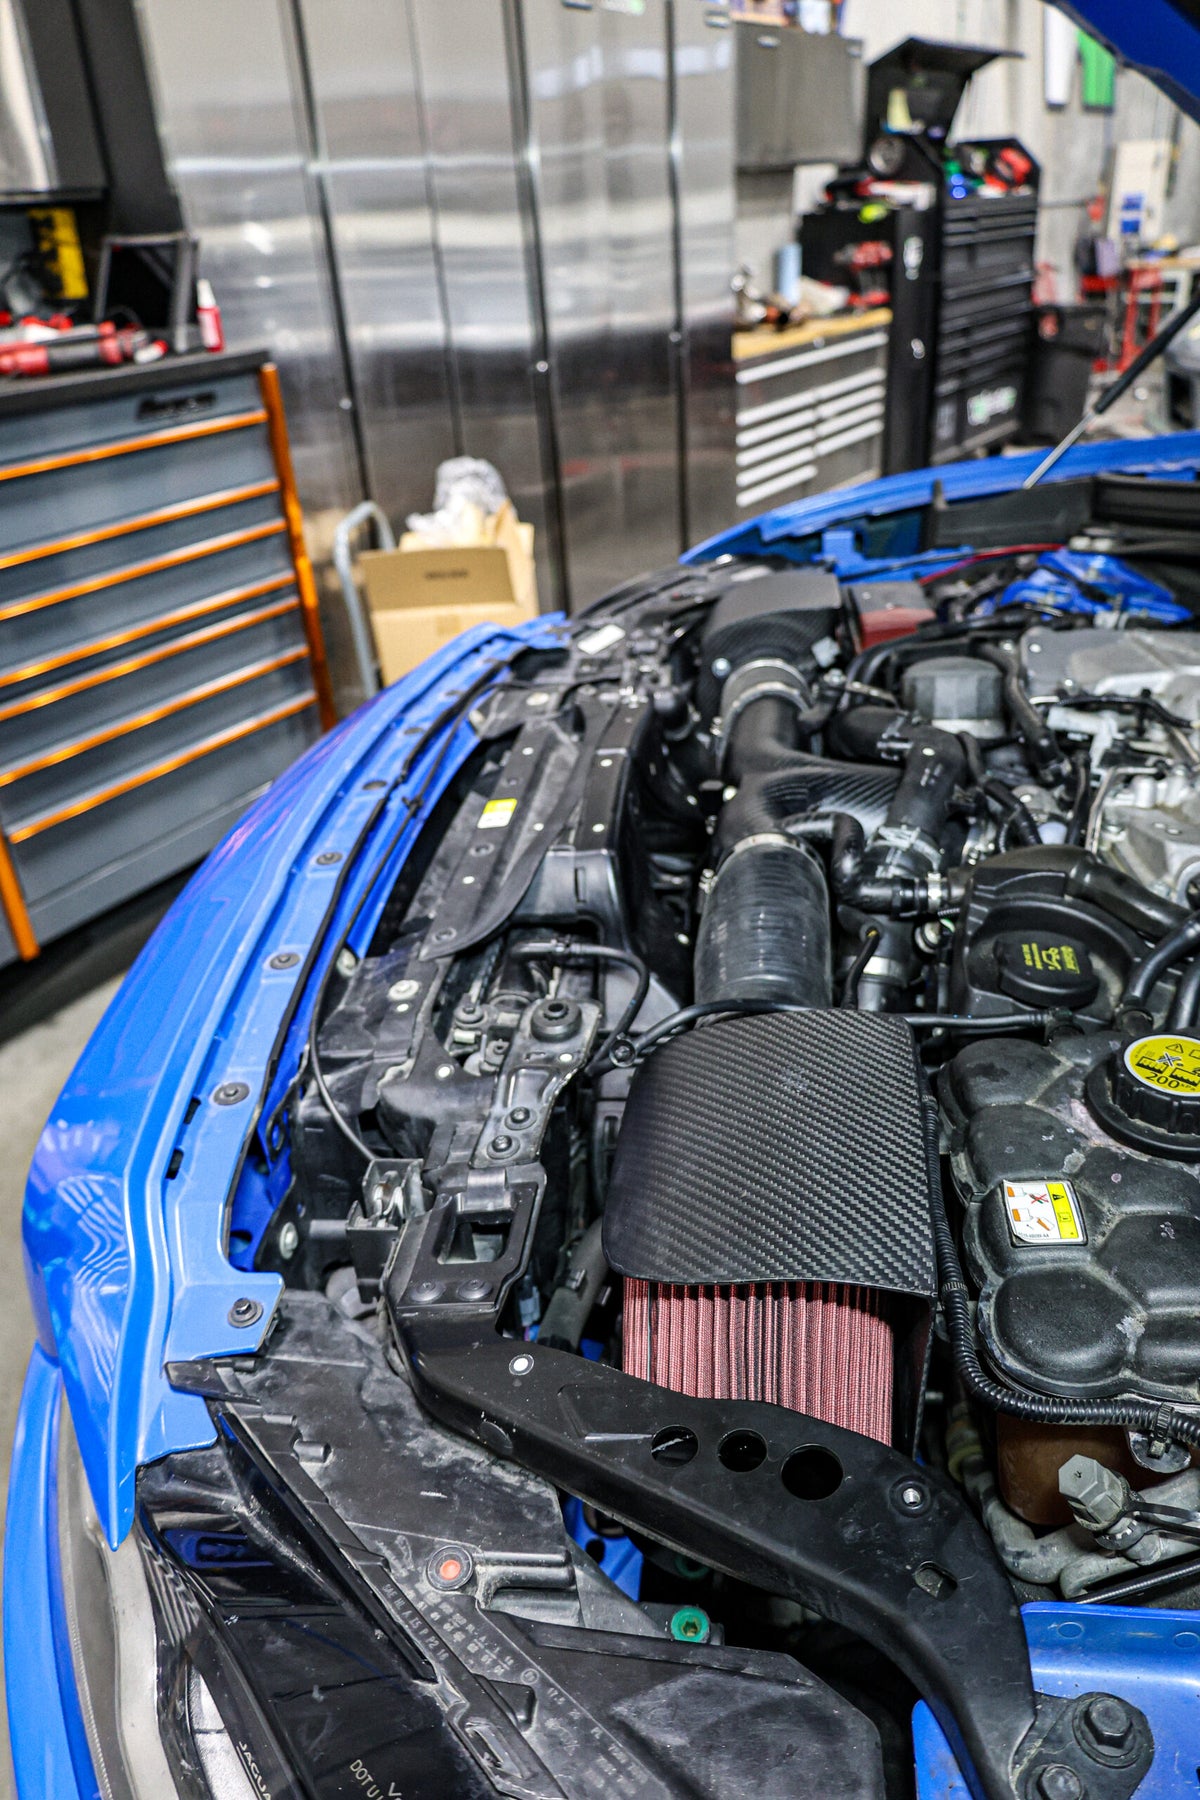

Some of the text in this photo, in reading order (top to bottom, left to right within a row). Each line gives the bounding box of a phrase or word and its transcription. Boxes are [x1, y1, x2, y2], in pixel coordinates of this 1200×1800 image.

[1145, 1071, 1180, 1089] 200
[382, 1584, 398, 1599] SAE
[349, 1759, 374, 1786] DOT
